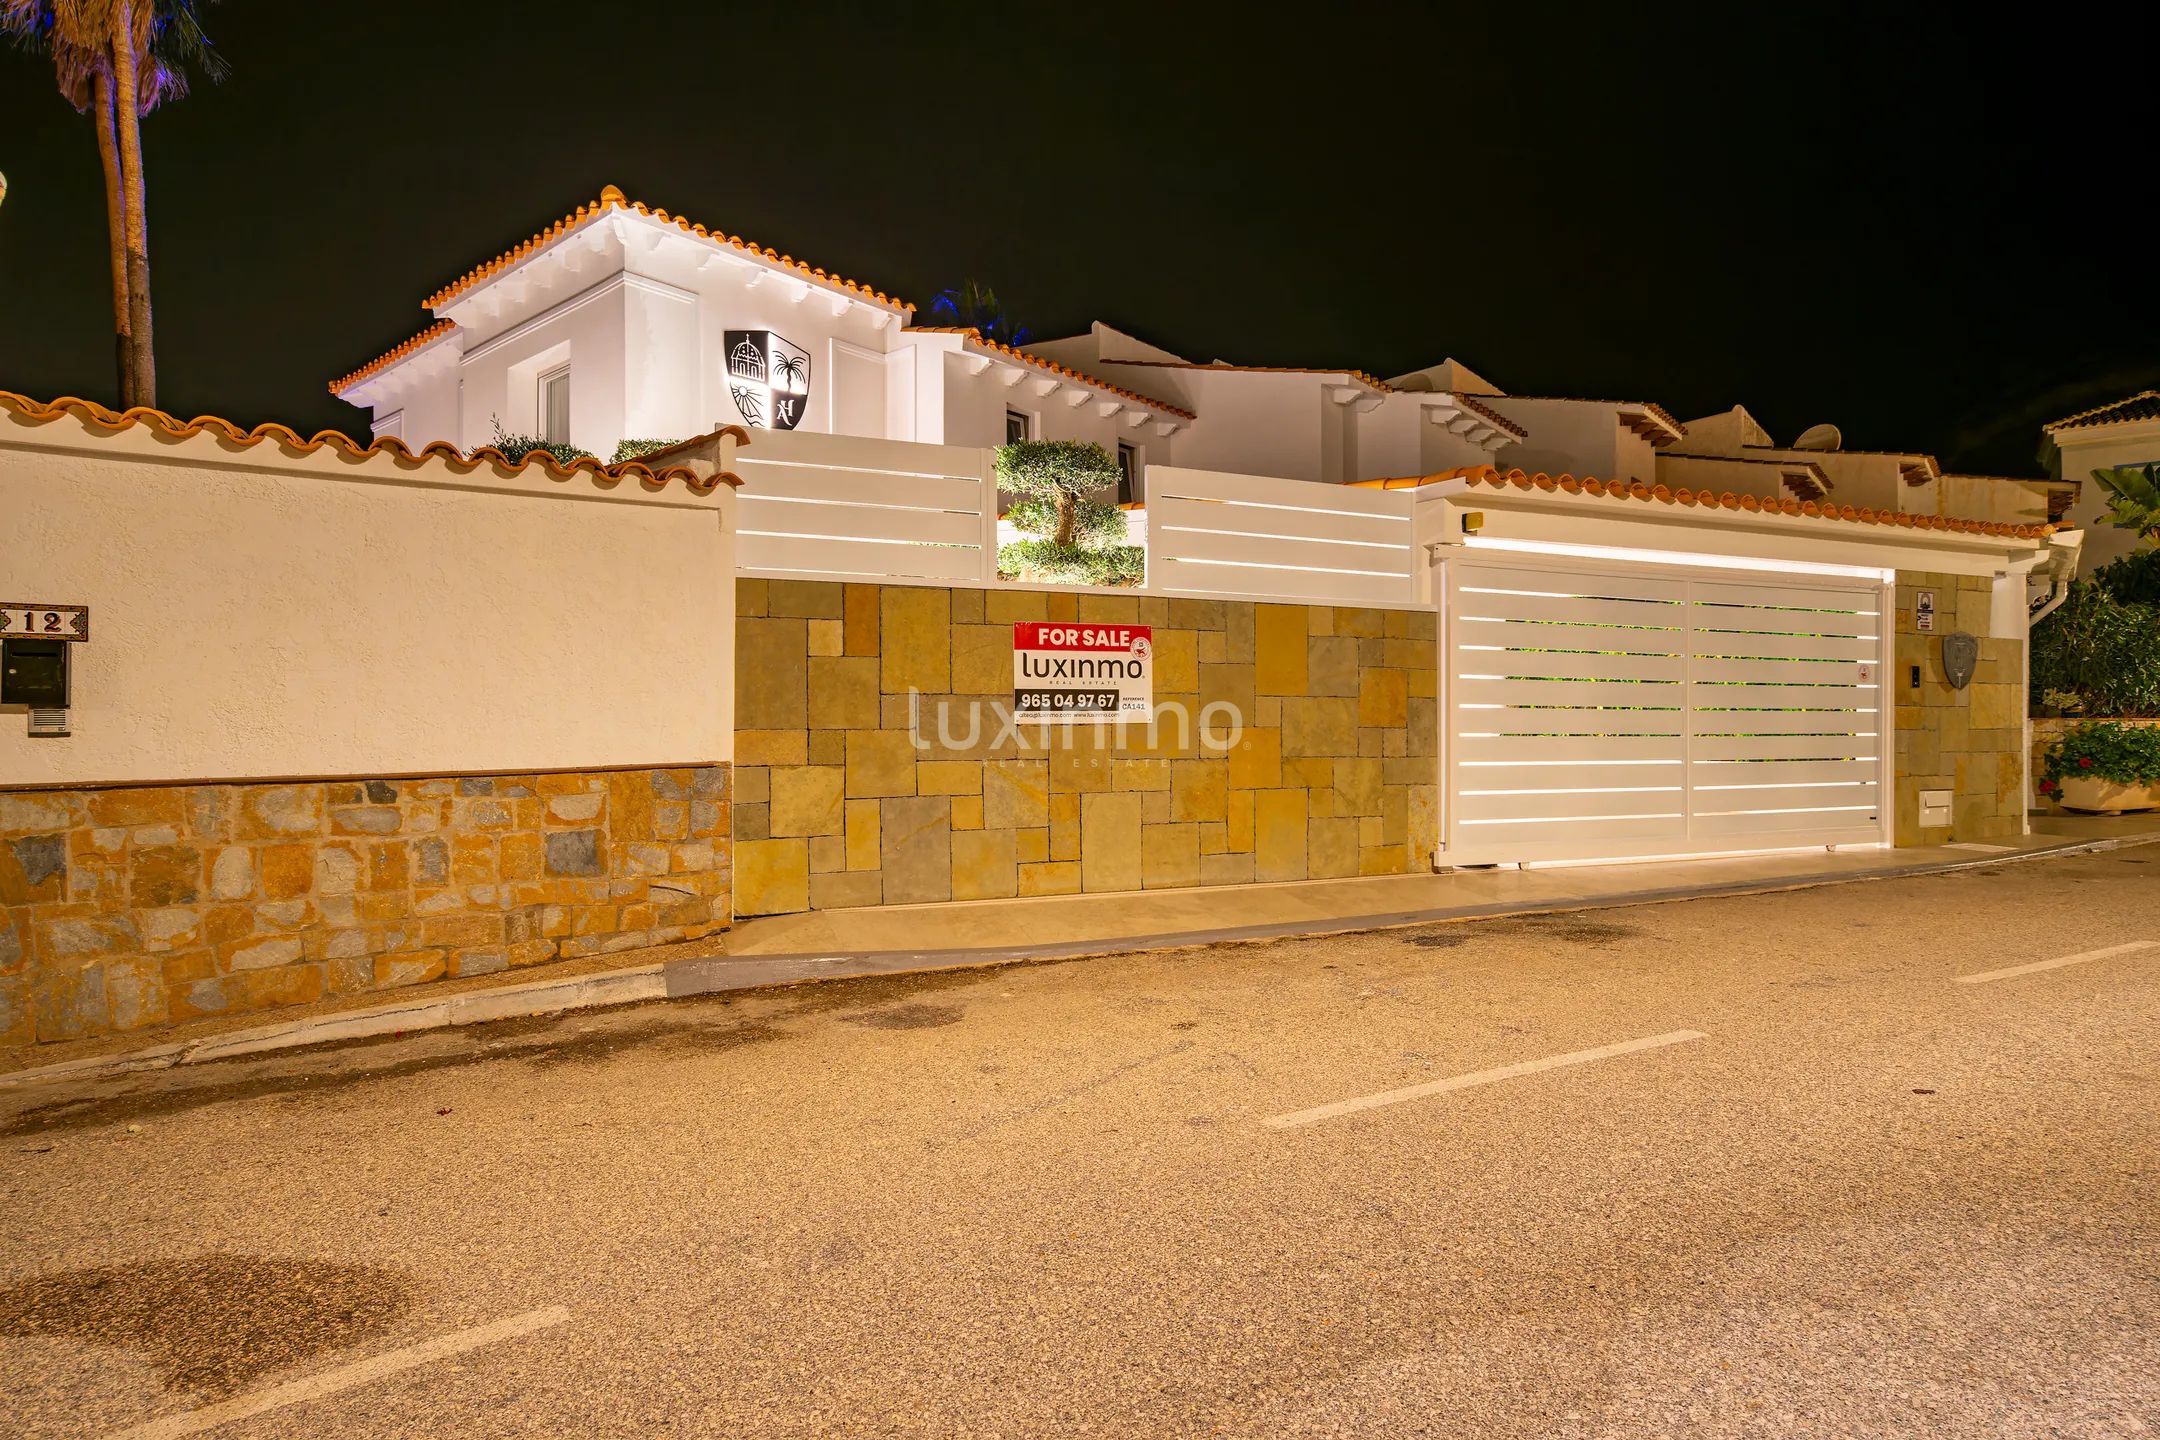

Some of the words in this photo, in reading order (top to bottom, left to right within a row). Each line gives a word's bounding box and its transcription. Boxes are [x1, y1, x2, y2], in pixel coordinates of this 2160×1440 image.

[24, 611, 62, 632] 12
[1038, 627, 1079, 646] FOR
[1083, 629, 1131, 647] SALE
[1022, 652, 1143, 679] luxinmo
[1021, 693, 1051, 708] 965
[1054, 694, 1074, 708] 04
[1077, 693, 1095, 708] 97
[1097, 693, 1115, 708] 67
